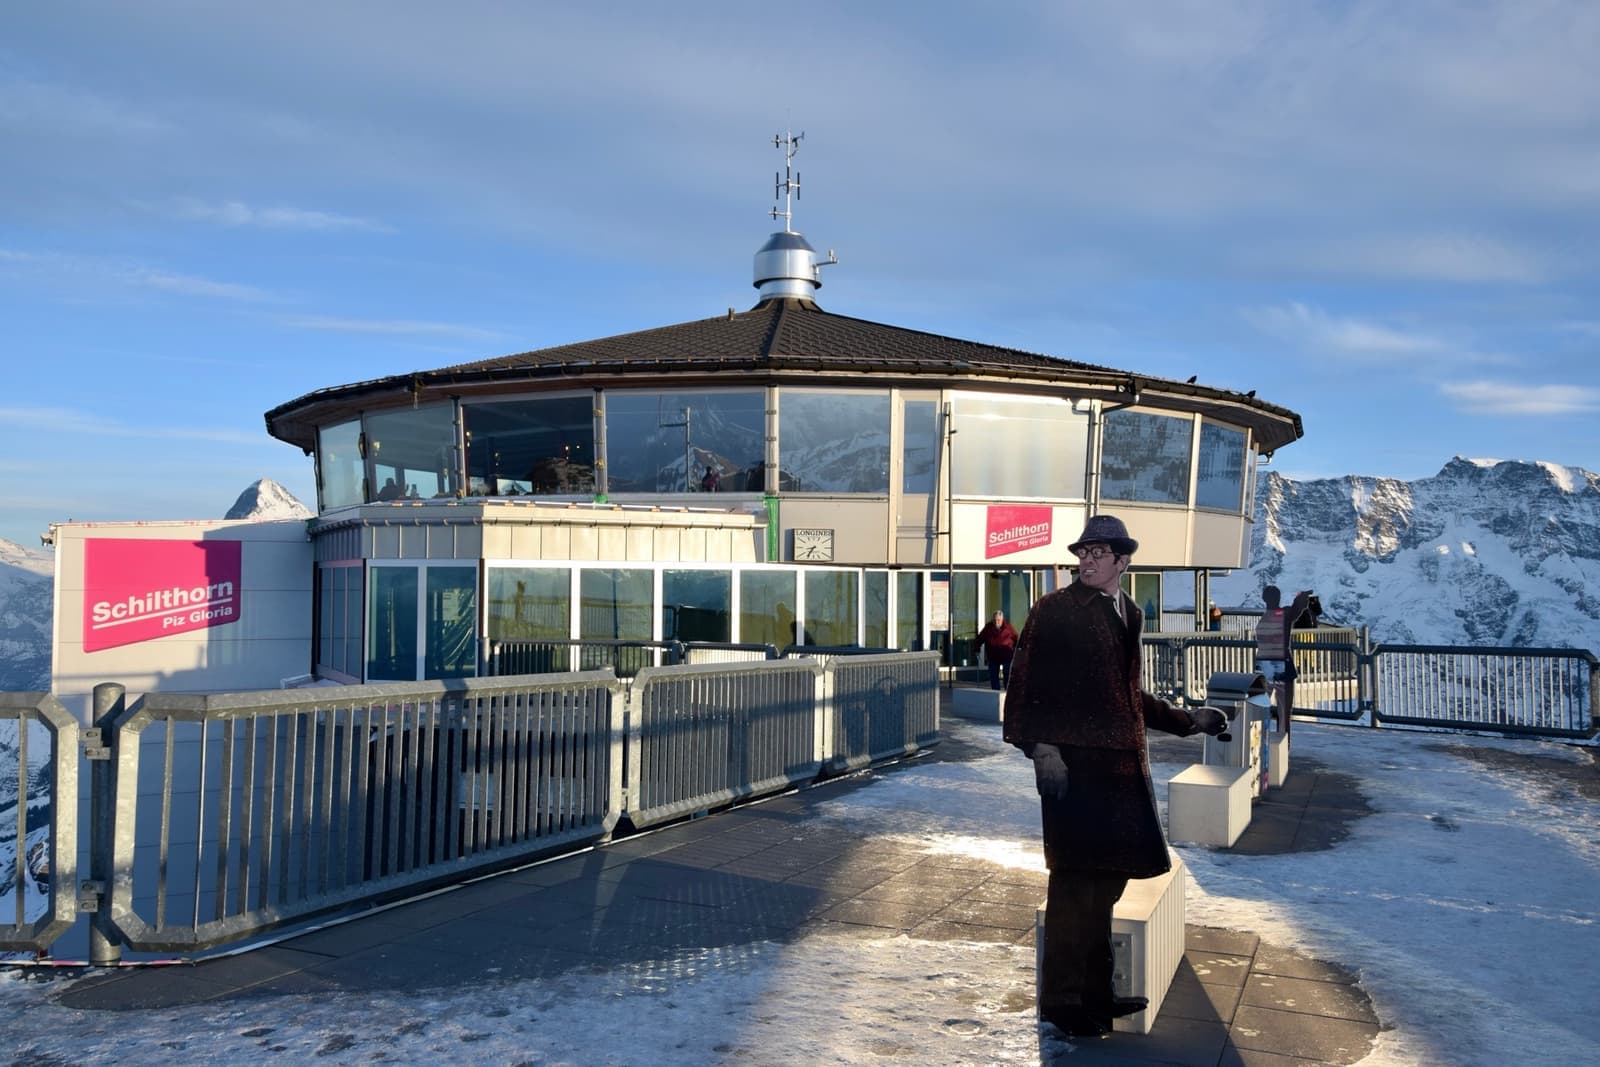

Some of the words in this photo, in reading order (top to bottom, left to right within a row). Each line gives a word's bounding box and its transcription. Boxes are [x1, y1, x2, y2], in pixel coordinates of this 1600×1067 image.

[989, 522, 1049, 543] Schilthorn
[92, 581, 233, 622] Schilthorn
[162, 615, 186, 629] Piz
[189, 605, 233, 623] Gloria
